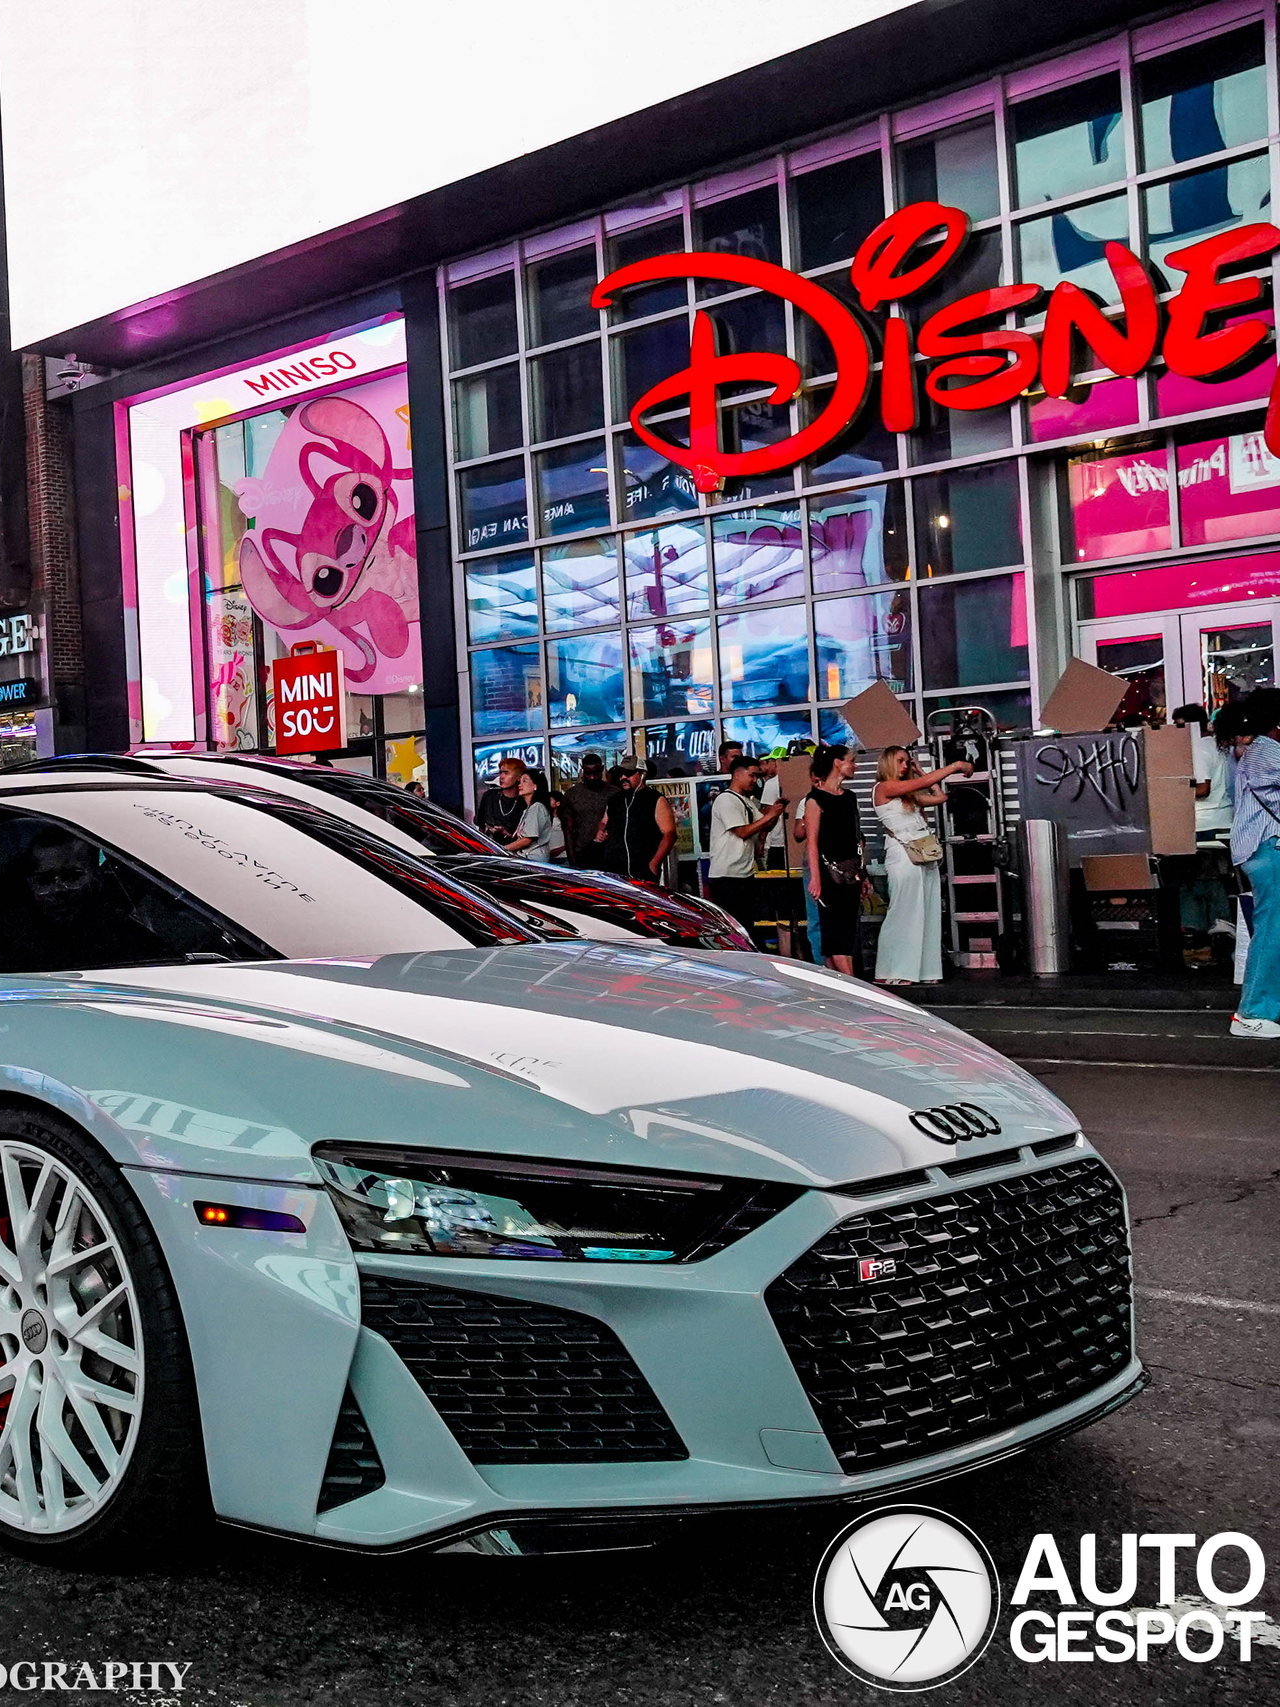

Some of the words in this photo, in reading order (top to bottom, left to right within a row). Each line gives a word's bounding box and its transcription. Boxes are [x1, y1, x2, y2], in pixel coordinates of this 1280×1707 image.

[591, 201, 1280, 492] DISNE
[243, 350, 357, 396] MINISO
[223, 598, 247, 614] Disney
[280, 672, 333, 703] MINI
[868, 1259, 896, 1277] R8
